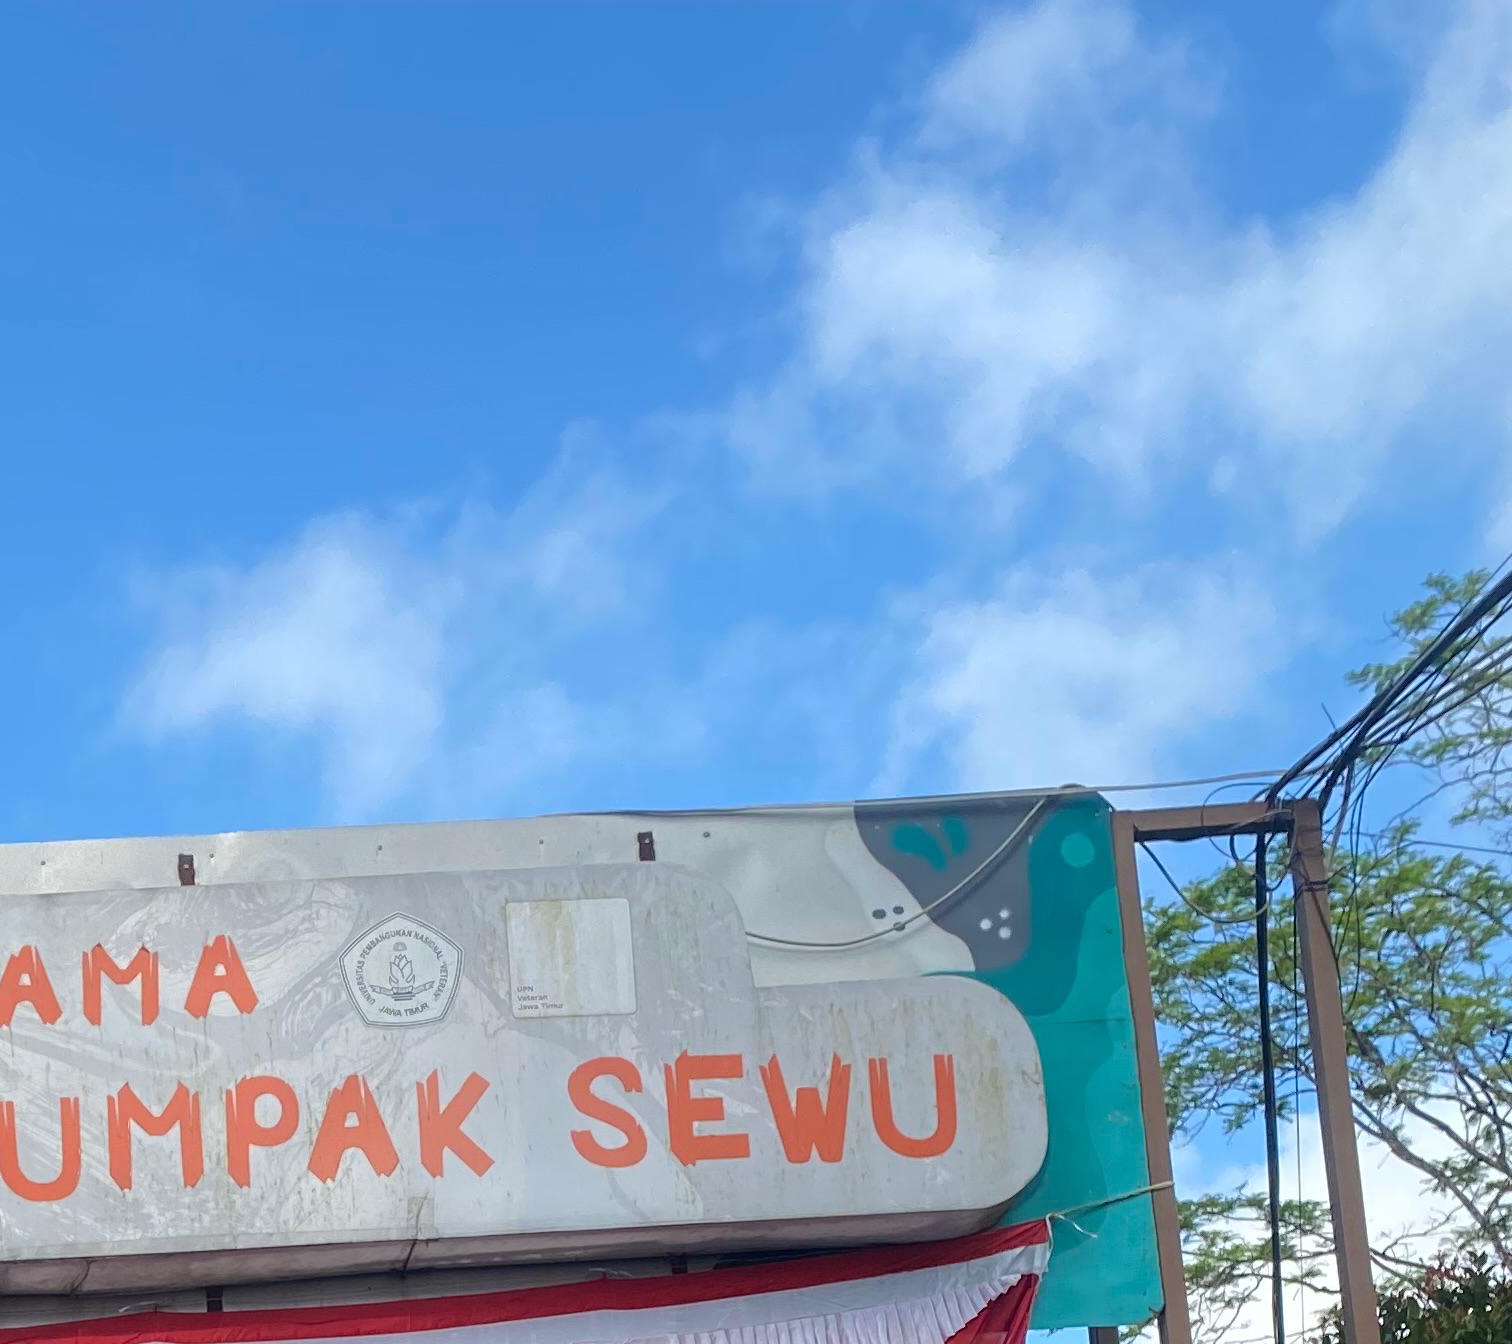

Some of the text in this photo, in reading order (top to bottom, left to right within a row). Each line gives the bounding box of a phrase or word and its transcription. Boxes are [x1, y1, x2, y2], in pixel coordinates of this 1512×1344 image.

[360, 929, 413, 959] PEMBANGUNAN
[414, 931, 443, 960] NASIONAL
[356, 960, 376, 1005] UNIVERSITAS
[379, 1002, 430, 1017] JAWA TIMUR
[569, 1053, 955, 1166] SEWU
